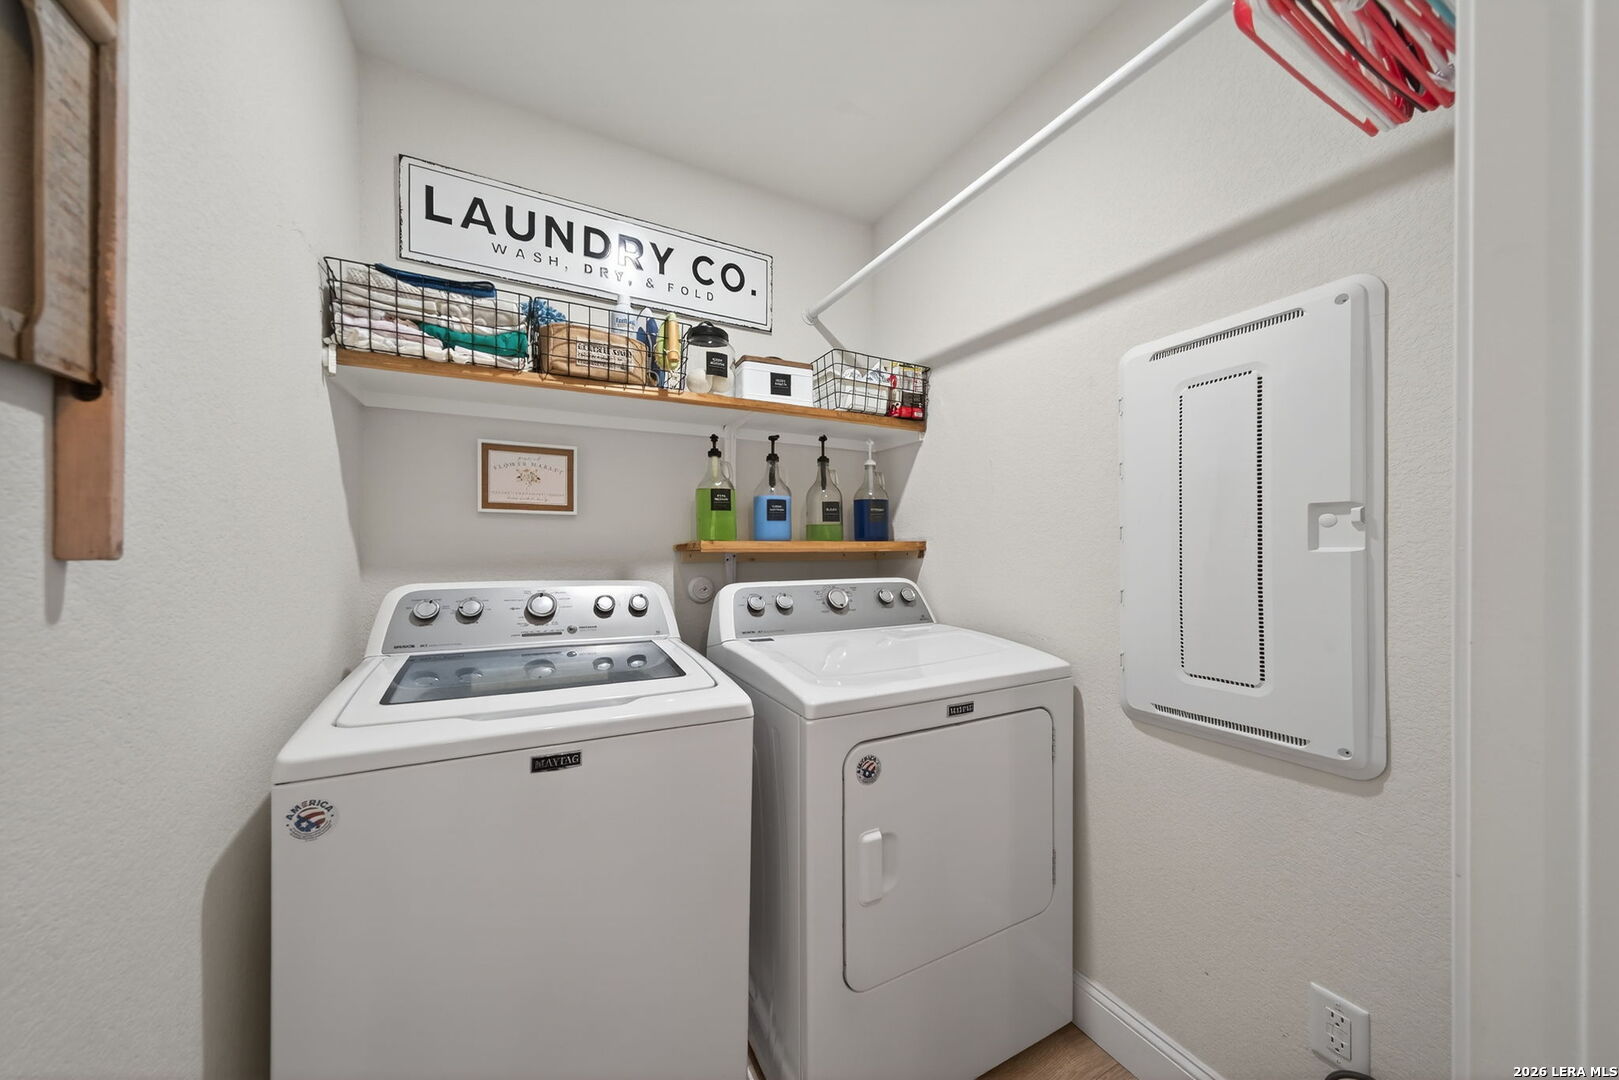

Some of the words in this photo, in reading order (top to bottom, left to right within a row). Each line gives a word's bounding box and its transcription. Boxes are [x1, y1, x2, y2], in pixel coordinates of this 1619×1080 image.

[425, 184, 674, 275] LAUNDRY
[691, 255, 757, 297] CO.
[491, 242, 569, 272] WASH,
[584, 264, 632, 286] DRY,
[645, 277, 655, 289] &
[667, 283, 714, 301] FOLD
[534, 754, 580, 769] MAYTAG
[286, 799, 334, 821] AMERICA
